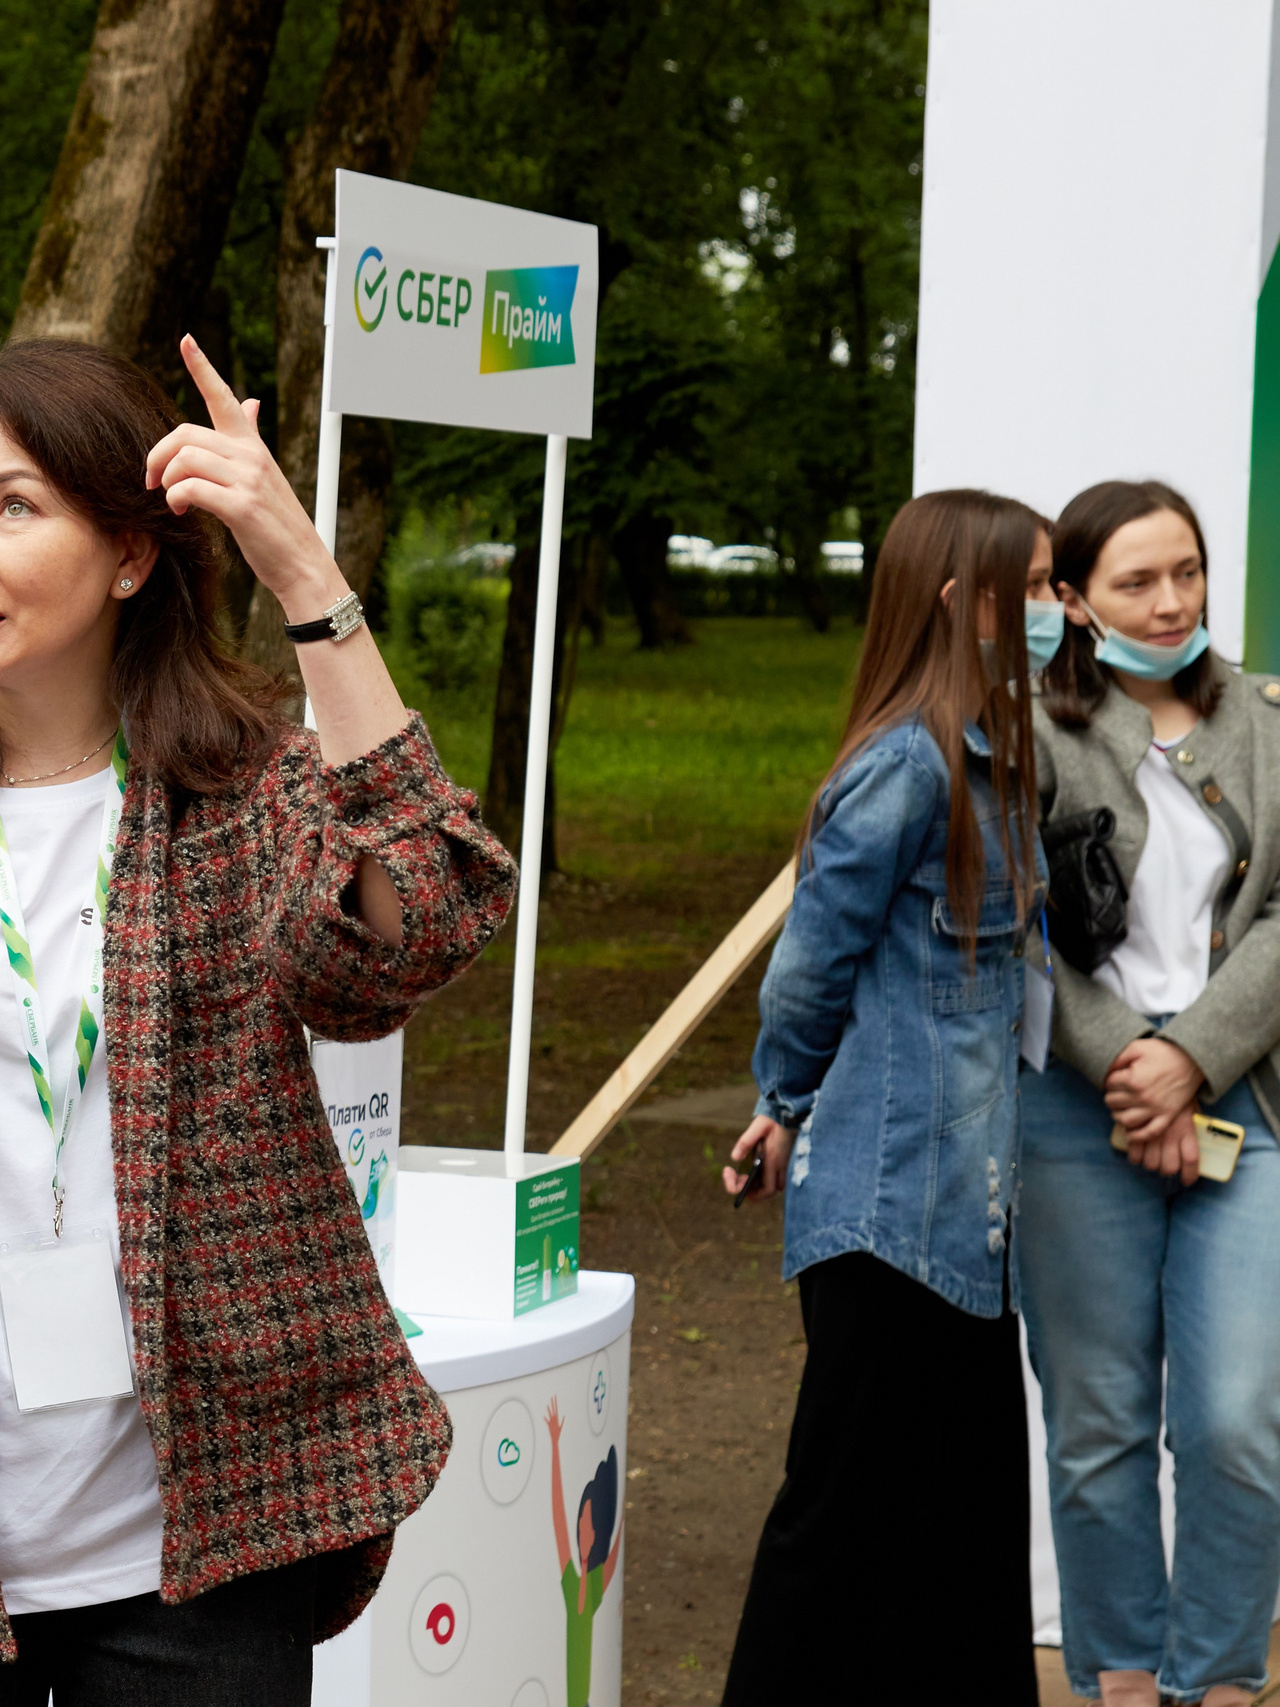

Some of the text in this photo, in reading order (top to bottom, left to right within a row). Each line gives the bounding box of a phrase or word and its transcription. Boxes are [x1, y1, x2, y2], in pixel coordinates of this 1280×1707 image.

[396, 268, 562, 349] СБЕР Прайм
[27, 1008, 40, 1047] СБЕРБАНК
[327, 1092, 389, 1127] Плати QR
